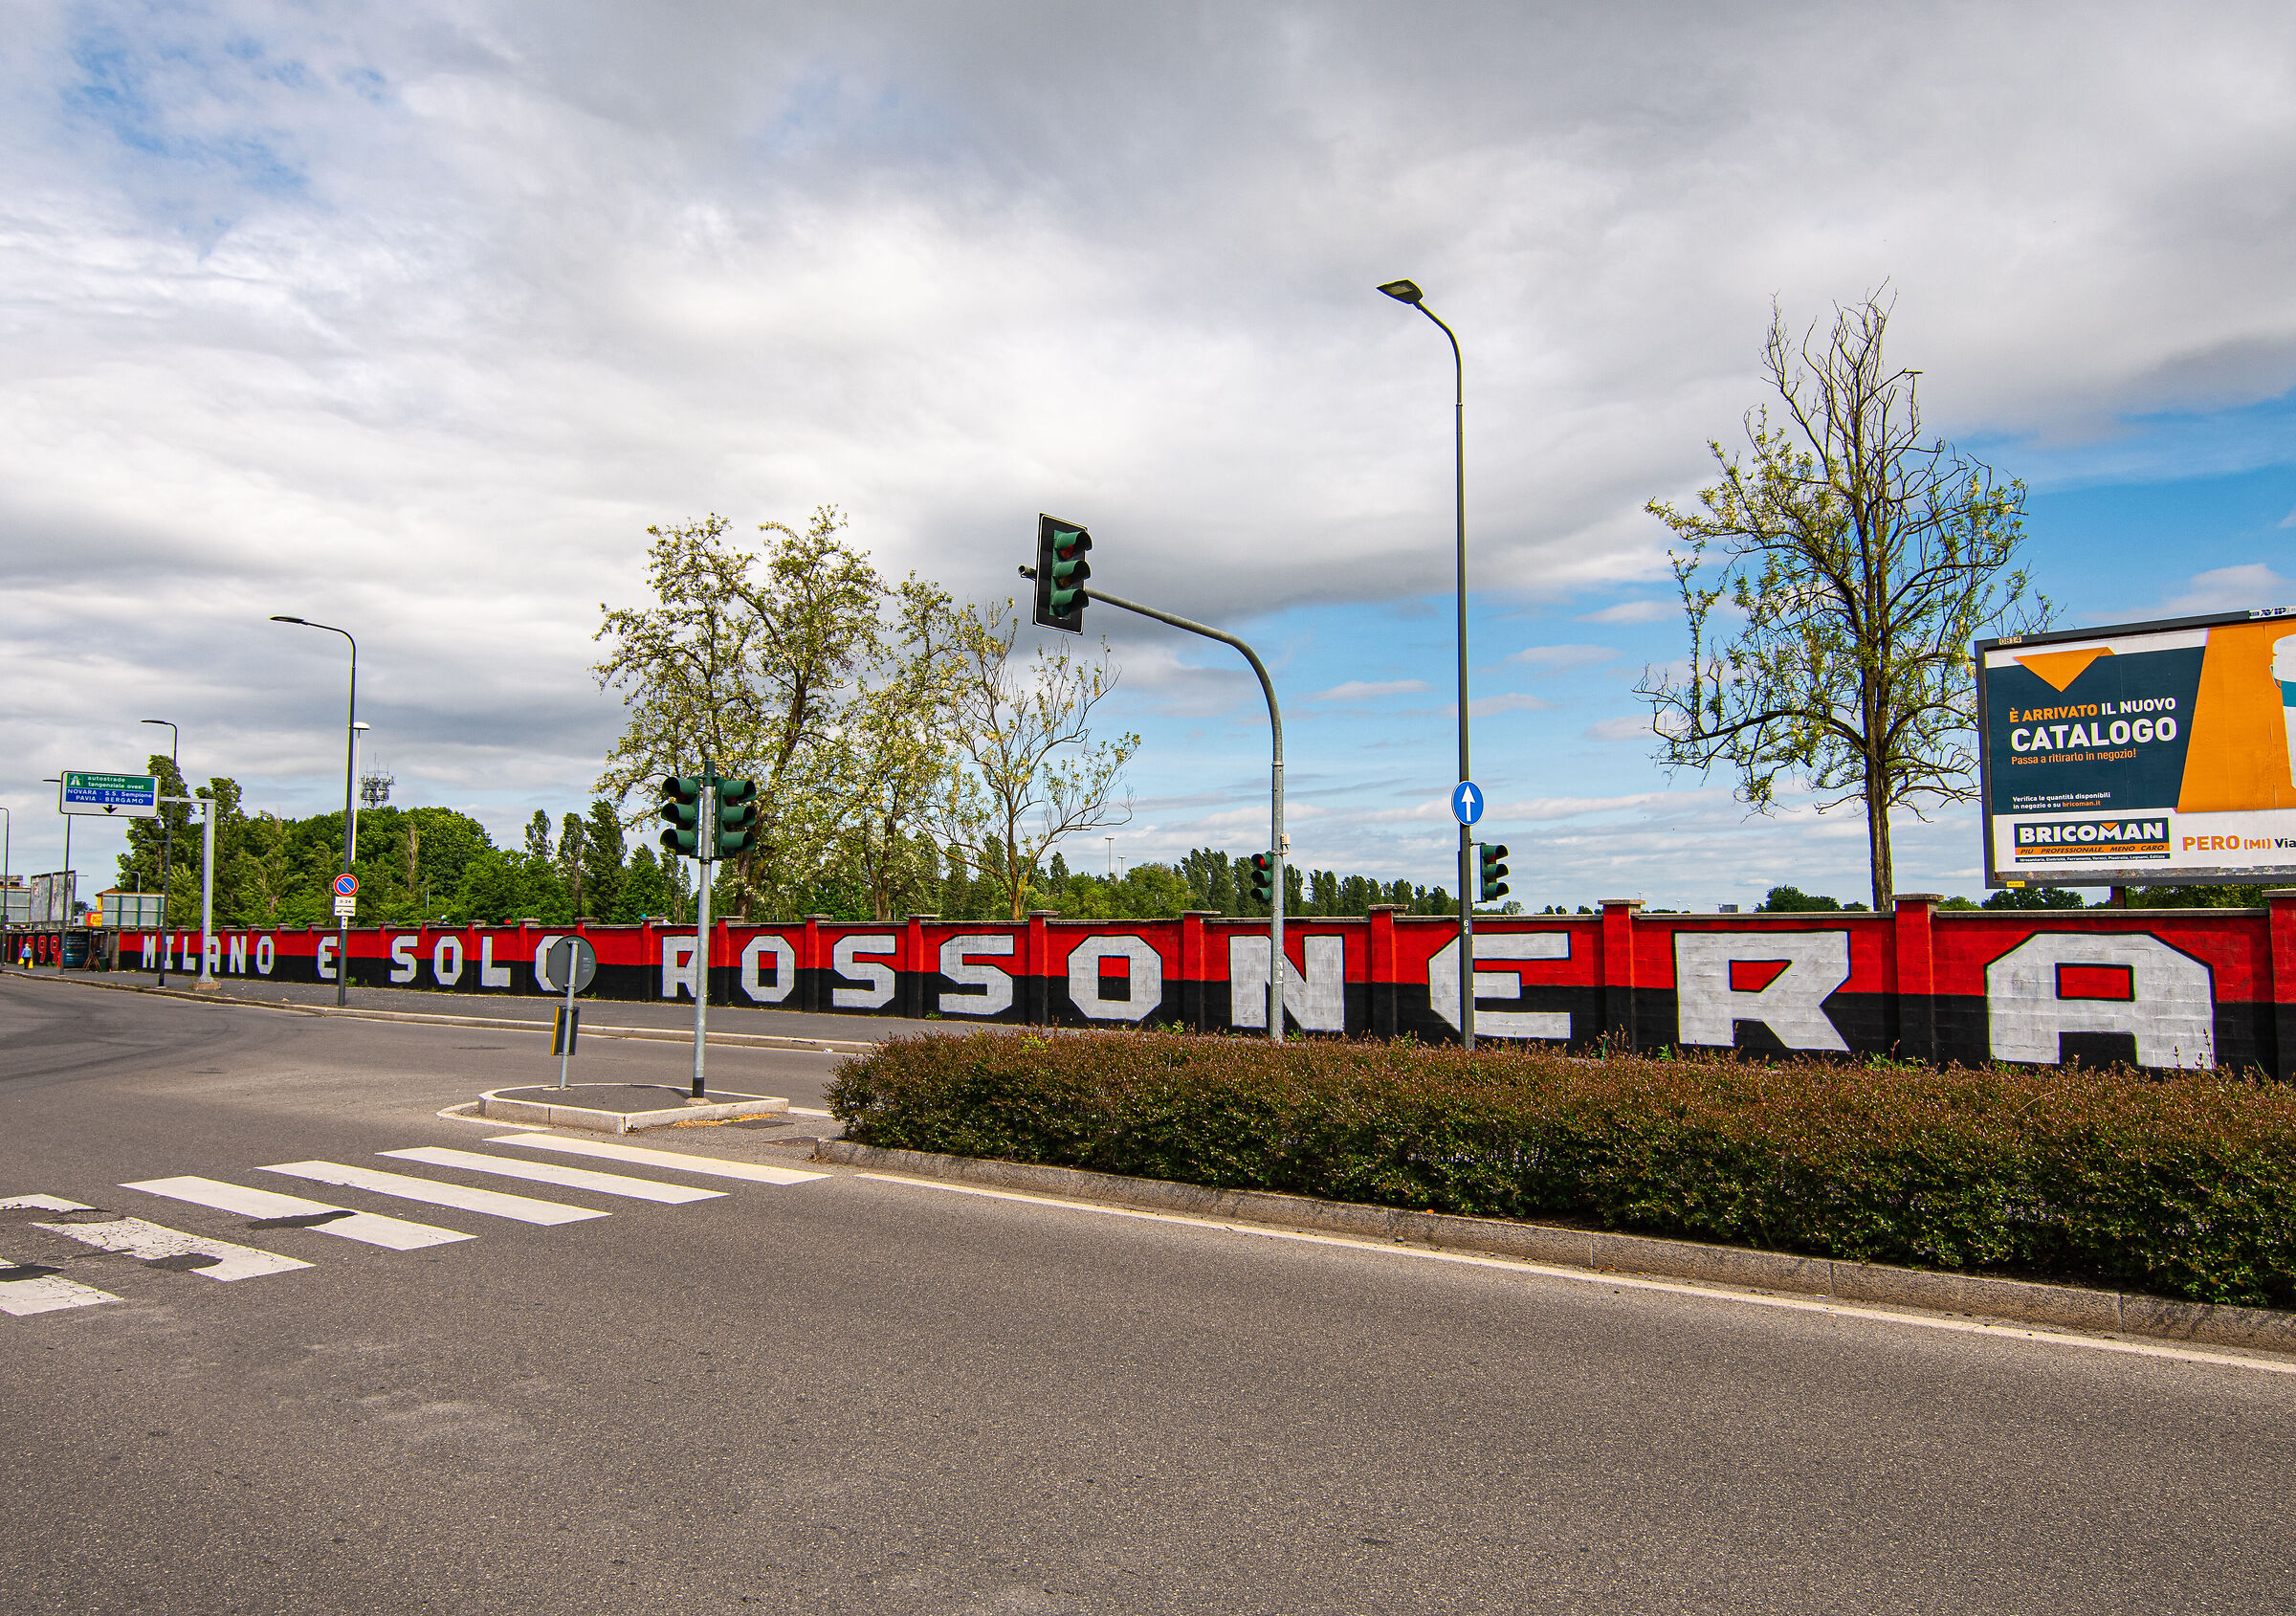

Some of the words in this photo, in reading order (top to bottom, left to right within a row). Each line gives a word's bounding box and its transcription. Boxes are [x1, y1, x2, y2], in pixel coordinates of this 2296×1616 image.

[2009, 707, 2019, 723] È
[2021, 704, 2098, 722] ARRIVATO
[2101, 702, 2116, 716] IL
[2120, 697, 2176, 714] NUOVO
[2011, 717, 2177, 752] CATALOGO
[2011, 755, 2040, 765] Passa
[2048, 752, 2084, 763] ritirarlo
[2086, 751, 2095, 761] in
[2096, 748, 2136, 762] negozio!
[2046, 793, 2074, 802] quantità
[2075, 791, 2110, 801] disponibili
[2020, 822, 2164, 844] BRICOMAN
[2182, 834, 2241, 852] PERO
[2243, 837, 2272, 851] (MI)
[2274, 837, 2296, 849] Via
[2020, 846, 2034, 854] PIÙ
[2041, 846, 2105, 854] PROFESSIONALE,
[142, 935, 276, 975] MILANO
[317, 935, 342, 980] E
[661, 931, 2215, 1071] ROSSONERA
